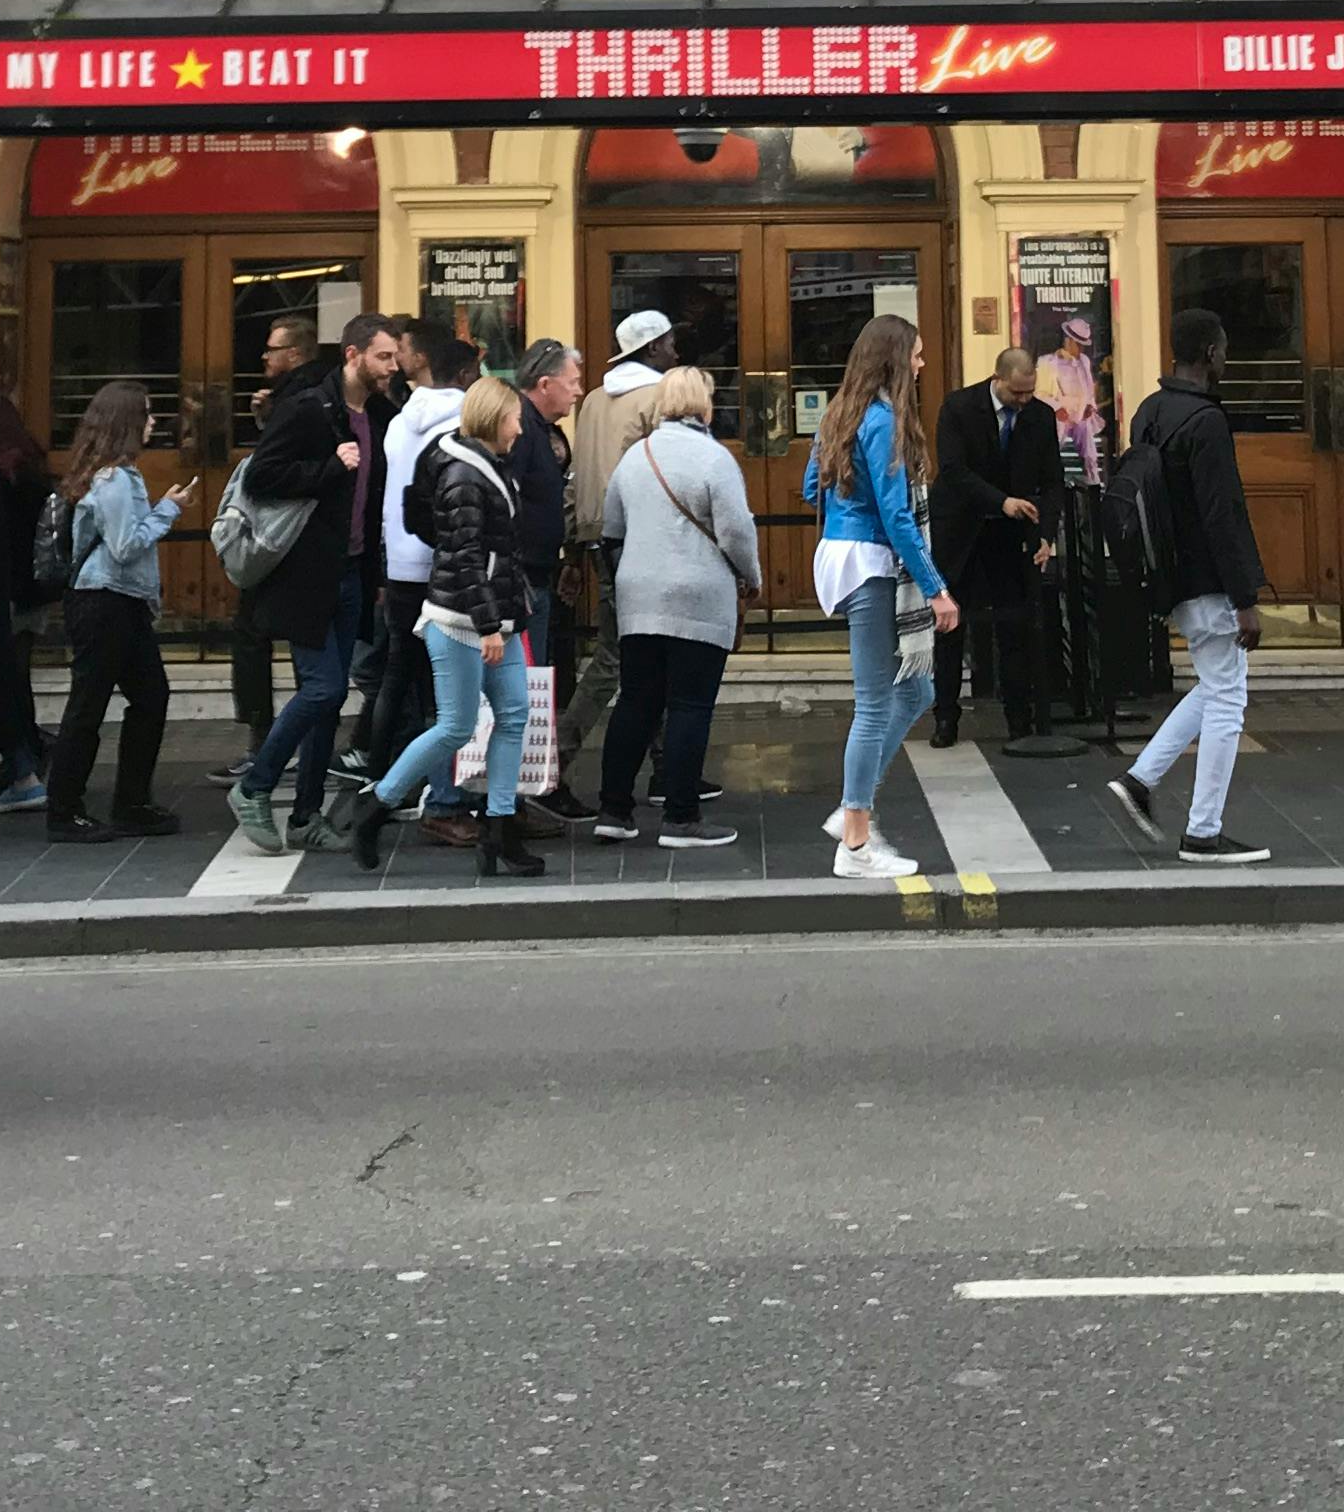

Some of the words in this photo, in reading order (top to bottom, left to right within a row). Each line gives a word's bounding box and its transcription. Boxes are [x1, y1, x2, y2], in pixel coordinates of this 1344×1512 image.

[6, 50, 59, 90] MY
[80, 50, 155, 88] LIFE
[222, 48, 312, 86] BEAT
[333, 47, 368, 85] IT
[524, 25, 917, 98] THRILLER
[919, 25, 1054, 92] Live
[1223, 34, 1315, 72] BILLIE
[72, 151, 178, 206] Live
[1187, 133, 1293, 188] Live
[431, 281, 486, 298] brilliantly
[444, 265, 482, 280] drilled
[484, 265, 505, 279] and
[1020, 268, 1051, 287] QUITE
[1053, 267, 1108, 287] LITERALLY,
[1035, 287, 1093, 304] THRILLING'
